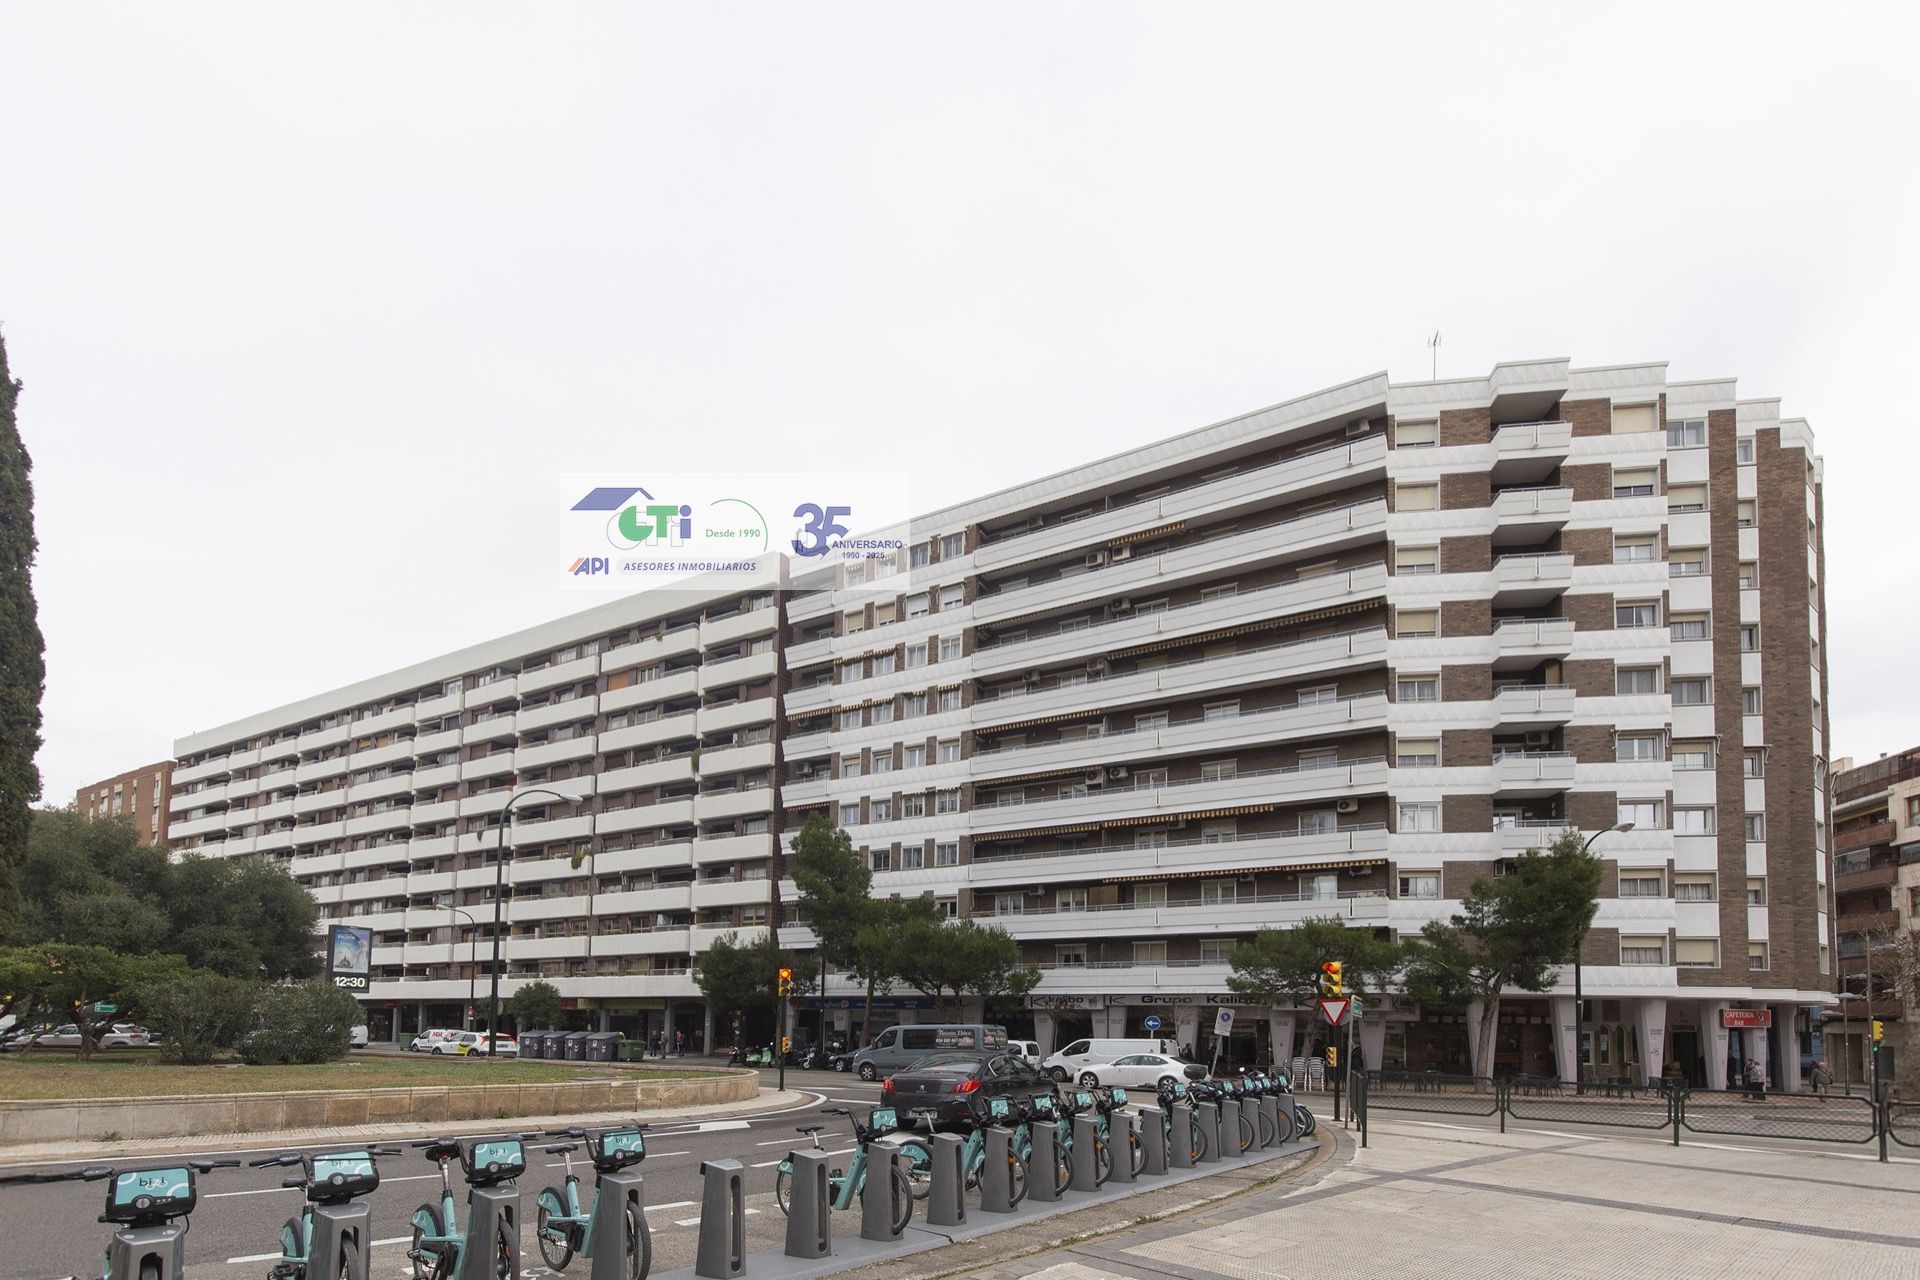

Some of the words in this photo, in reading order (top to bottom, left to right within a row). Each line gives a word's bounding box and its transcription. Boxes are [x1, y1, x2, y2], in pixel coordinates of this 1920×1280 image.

[335, 976, 365, 988] 12:30
[1141, 995, 1193, 1005] Grupo
[1725, 1011, 1754, 1019] CAFETERIA
[139, 1177, 168, 1190] bizi
